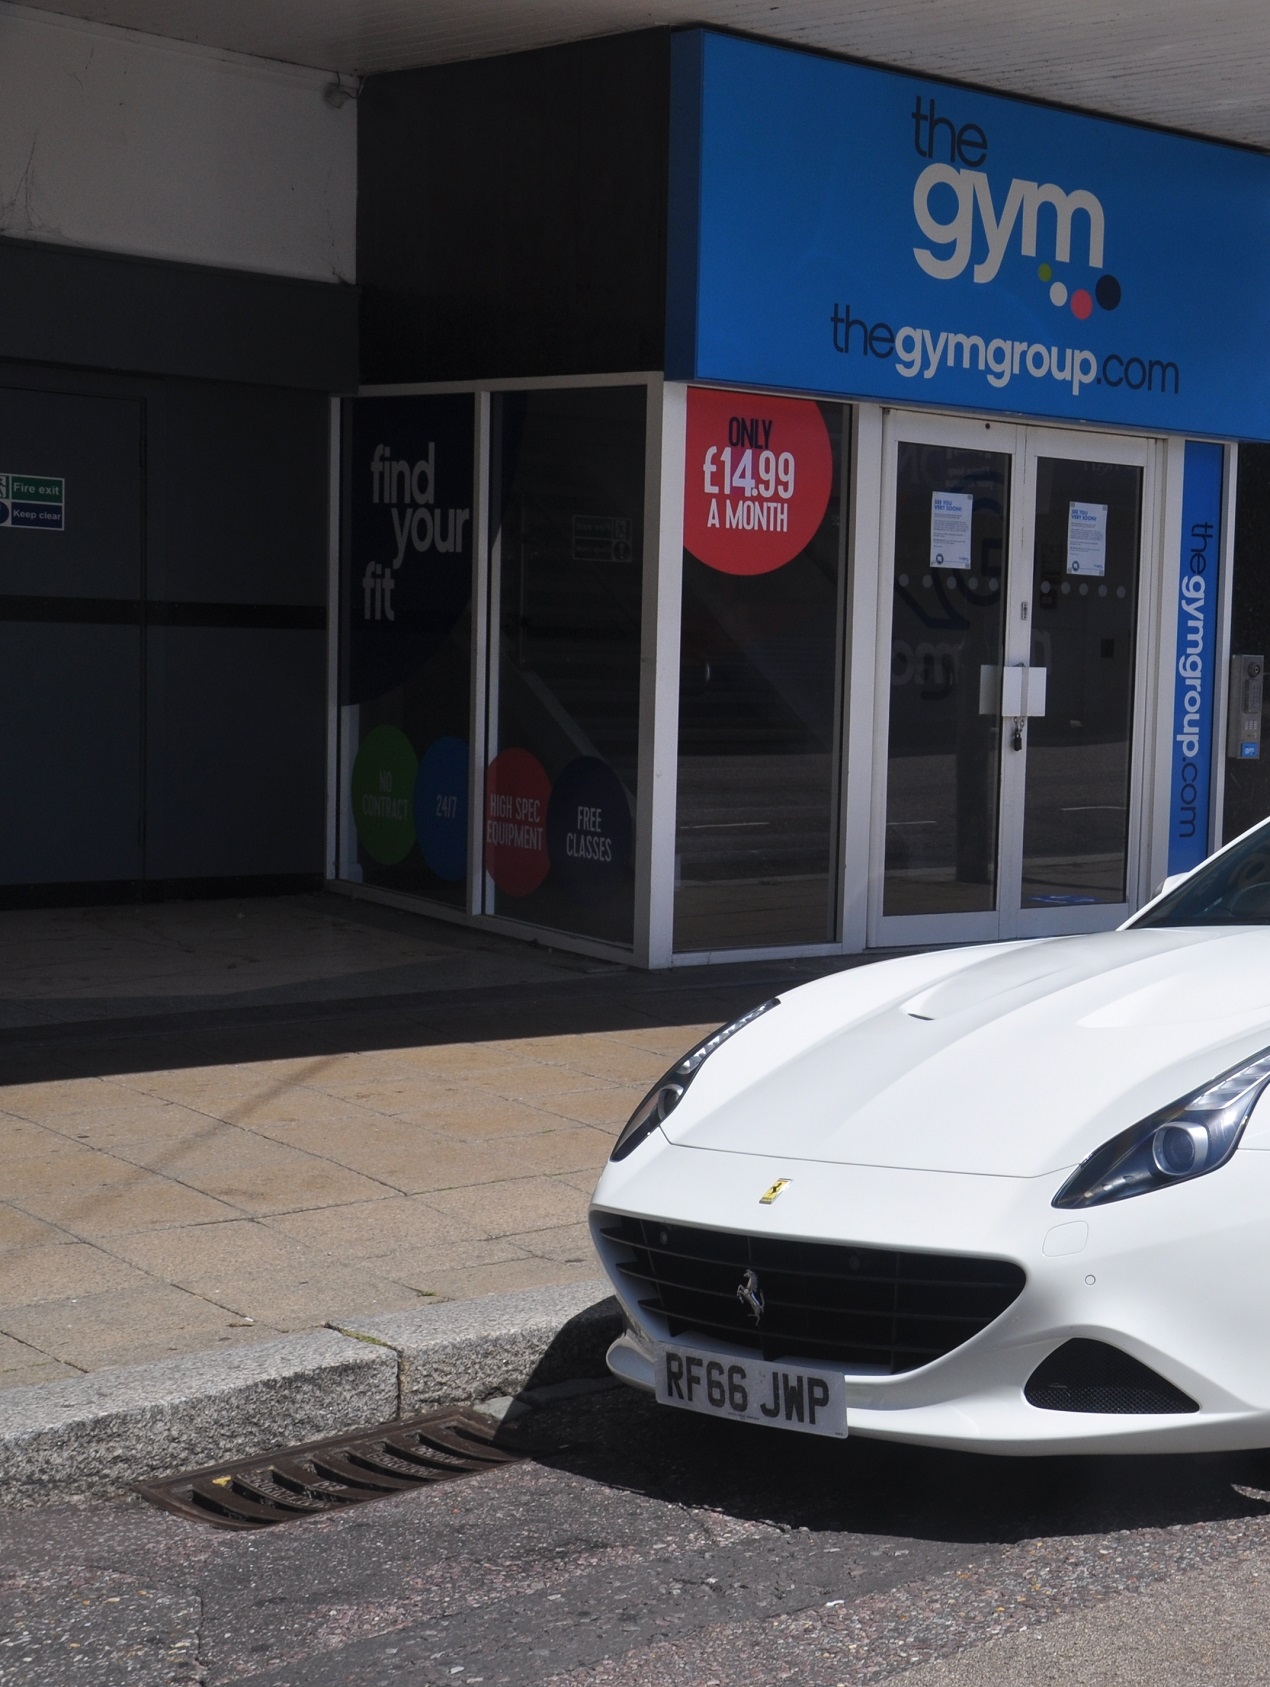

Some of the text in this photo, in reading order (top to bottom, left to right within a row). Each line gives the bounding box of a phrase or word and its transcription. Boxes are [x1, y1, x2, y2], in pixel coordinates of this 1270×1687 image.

[911, 95, 988, 167] the
[912, 162, 1105, 284] gym
[830, 302, 1180, 396] thegymgroup.com
[728, 416, 773, 450] ONLY
[13, 482, 60, 495] Fire exit
[370, 441, 436, 505] find
[703, 446, 795, 499] £14.99
[13, 509, 61, 520] Keep clear
[707, 498, 788, 533] A MONTH
[390, 507, 470, 571] your
[362, 560, 395, 622] fit
[1176, 521, 1214, 838] thegymgroup.com
[379, 771, 392, 792] NO
[362, 794, 409, 821] CONTRACT
[435, 794, 458, 819] 24/7
[490, 794, 541, 824] HIGH SPEC
[577, 805, 603, 833] FREE
[486, 822, 543, 851] EQUIPMENT
[566, 832, 612, 863] CLASSES
[665, 1351, 830, 1425] RF66 JWP
